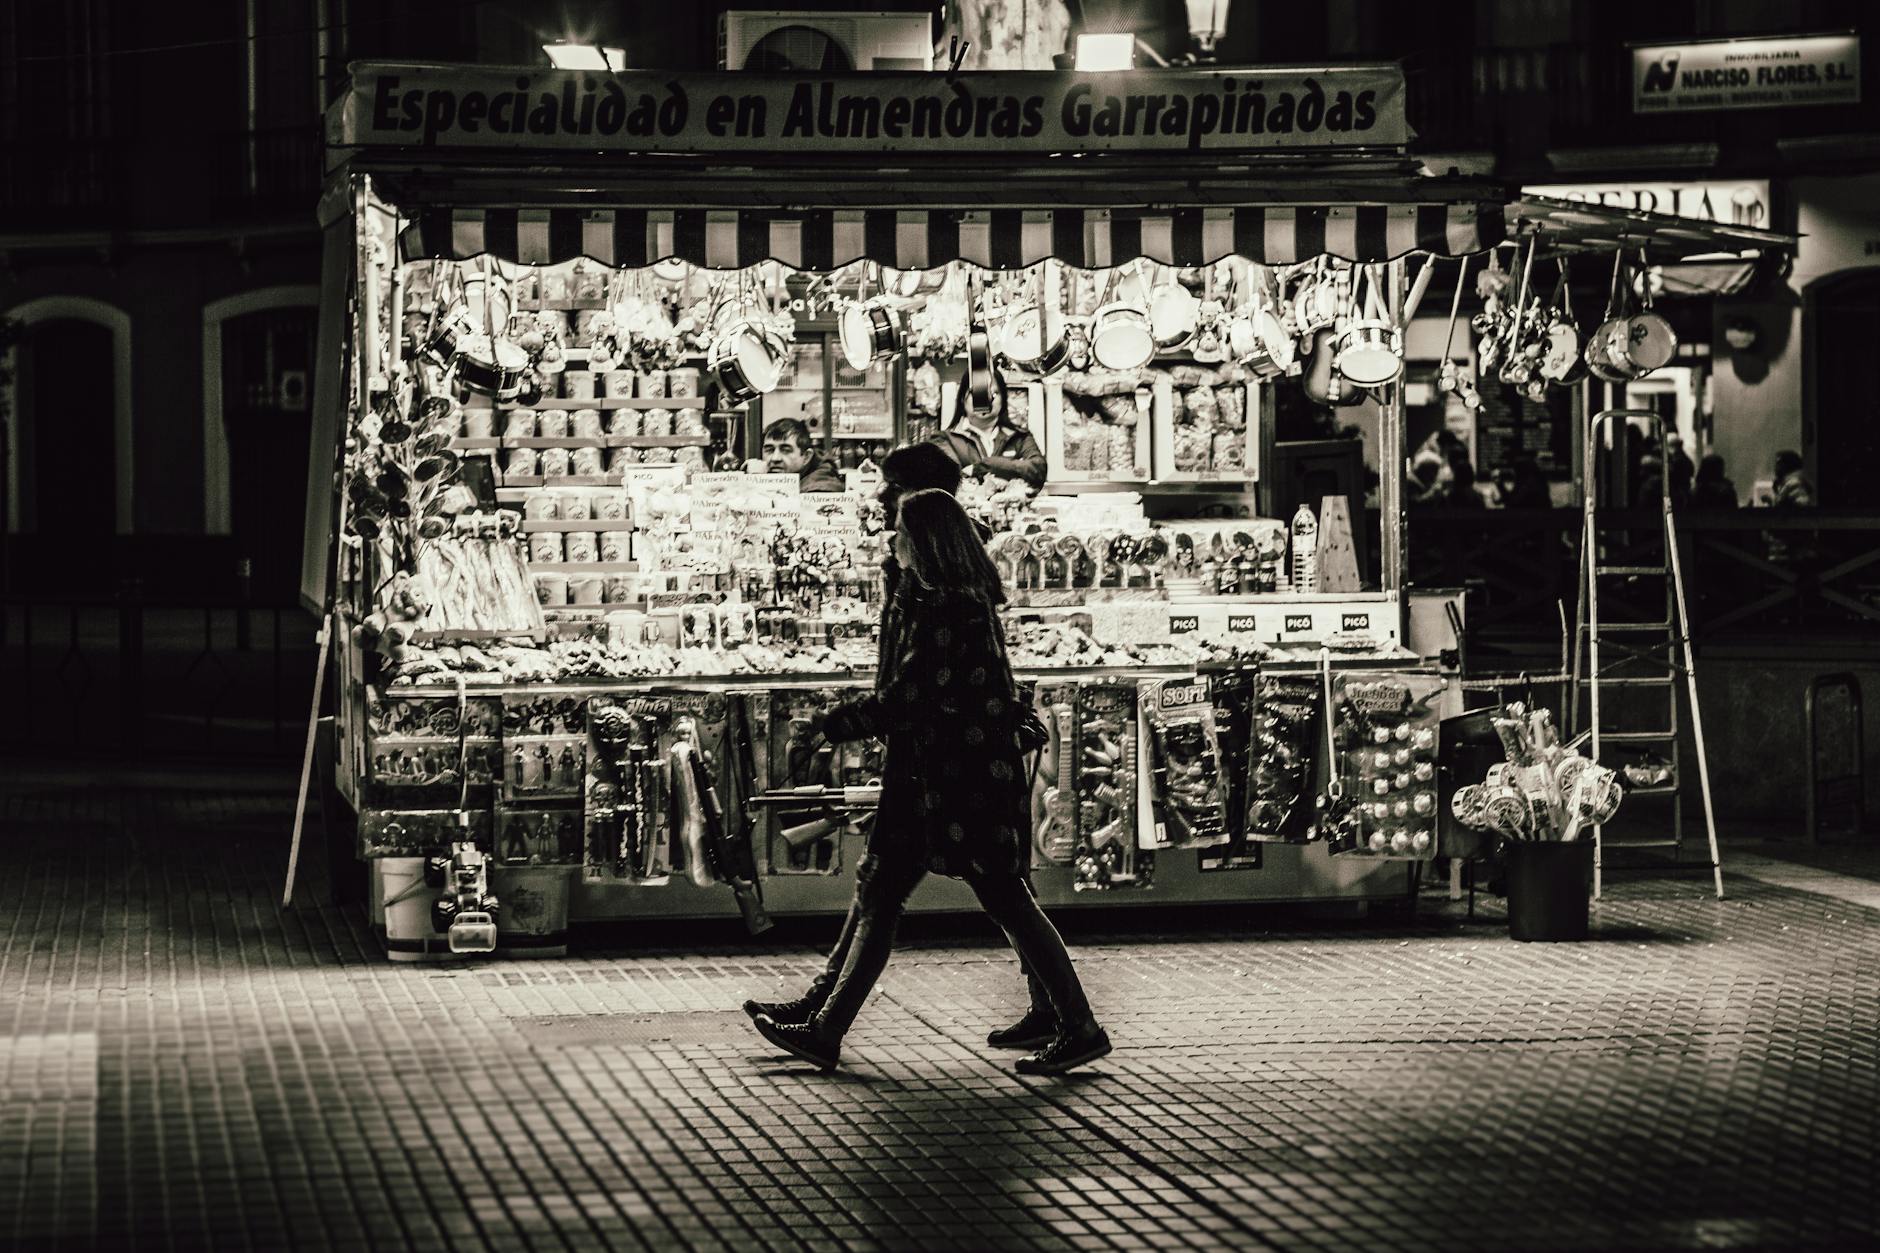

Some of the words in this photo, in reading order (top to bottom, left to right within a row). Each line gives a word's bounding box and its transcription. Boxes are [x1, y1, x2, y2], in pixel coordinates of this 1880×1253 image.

[1725, 50, 1801, 63] INMOBILIARIA
[1681, 68, 1750, 88] NARCISO
[1757, 64, 1822, 86] FLORES,
[1825, 63, 1855, 82] S.L.
[372, 75, 689, 145] Especialidad
[706, 94, 767, 138] en
[781, 81, 1045, 139] Almendras
[1061, 77, 1376, 149] Garrapiñadas
[810, 495, 854, 503] Almendro
[756, 510, 800, 519] Almendro
[1162, 685, 1207, 706] SOFT
[1356, 699, 1399, 709] Pesca
